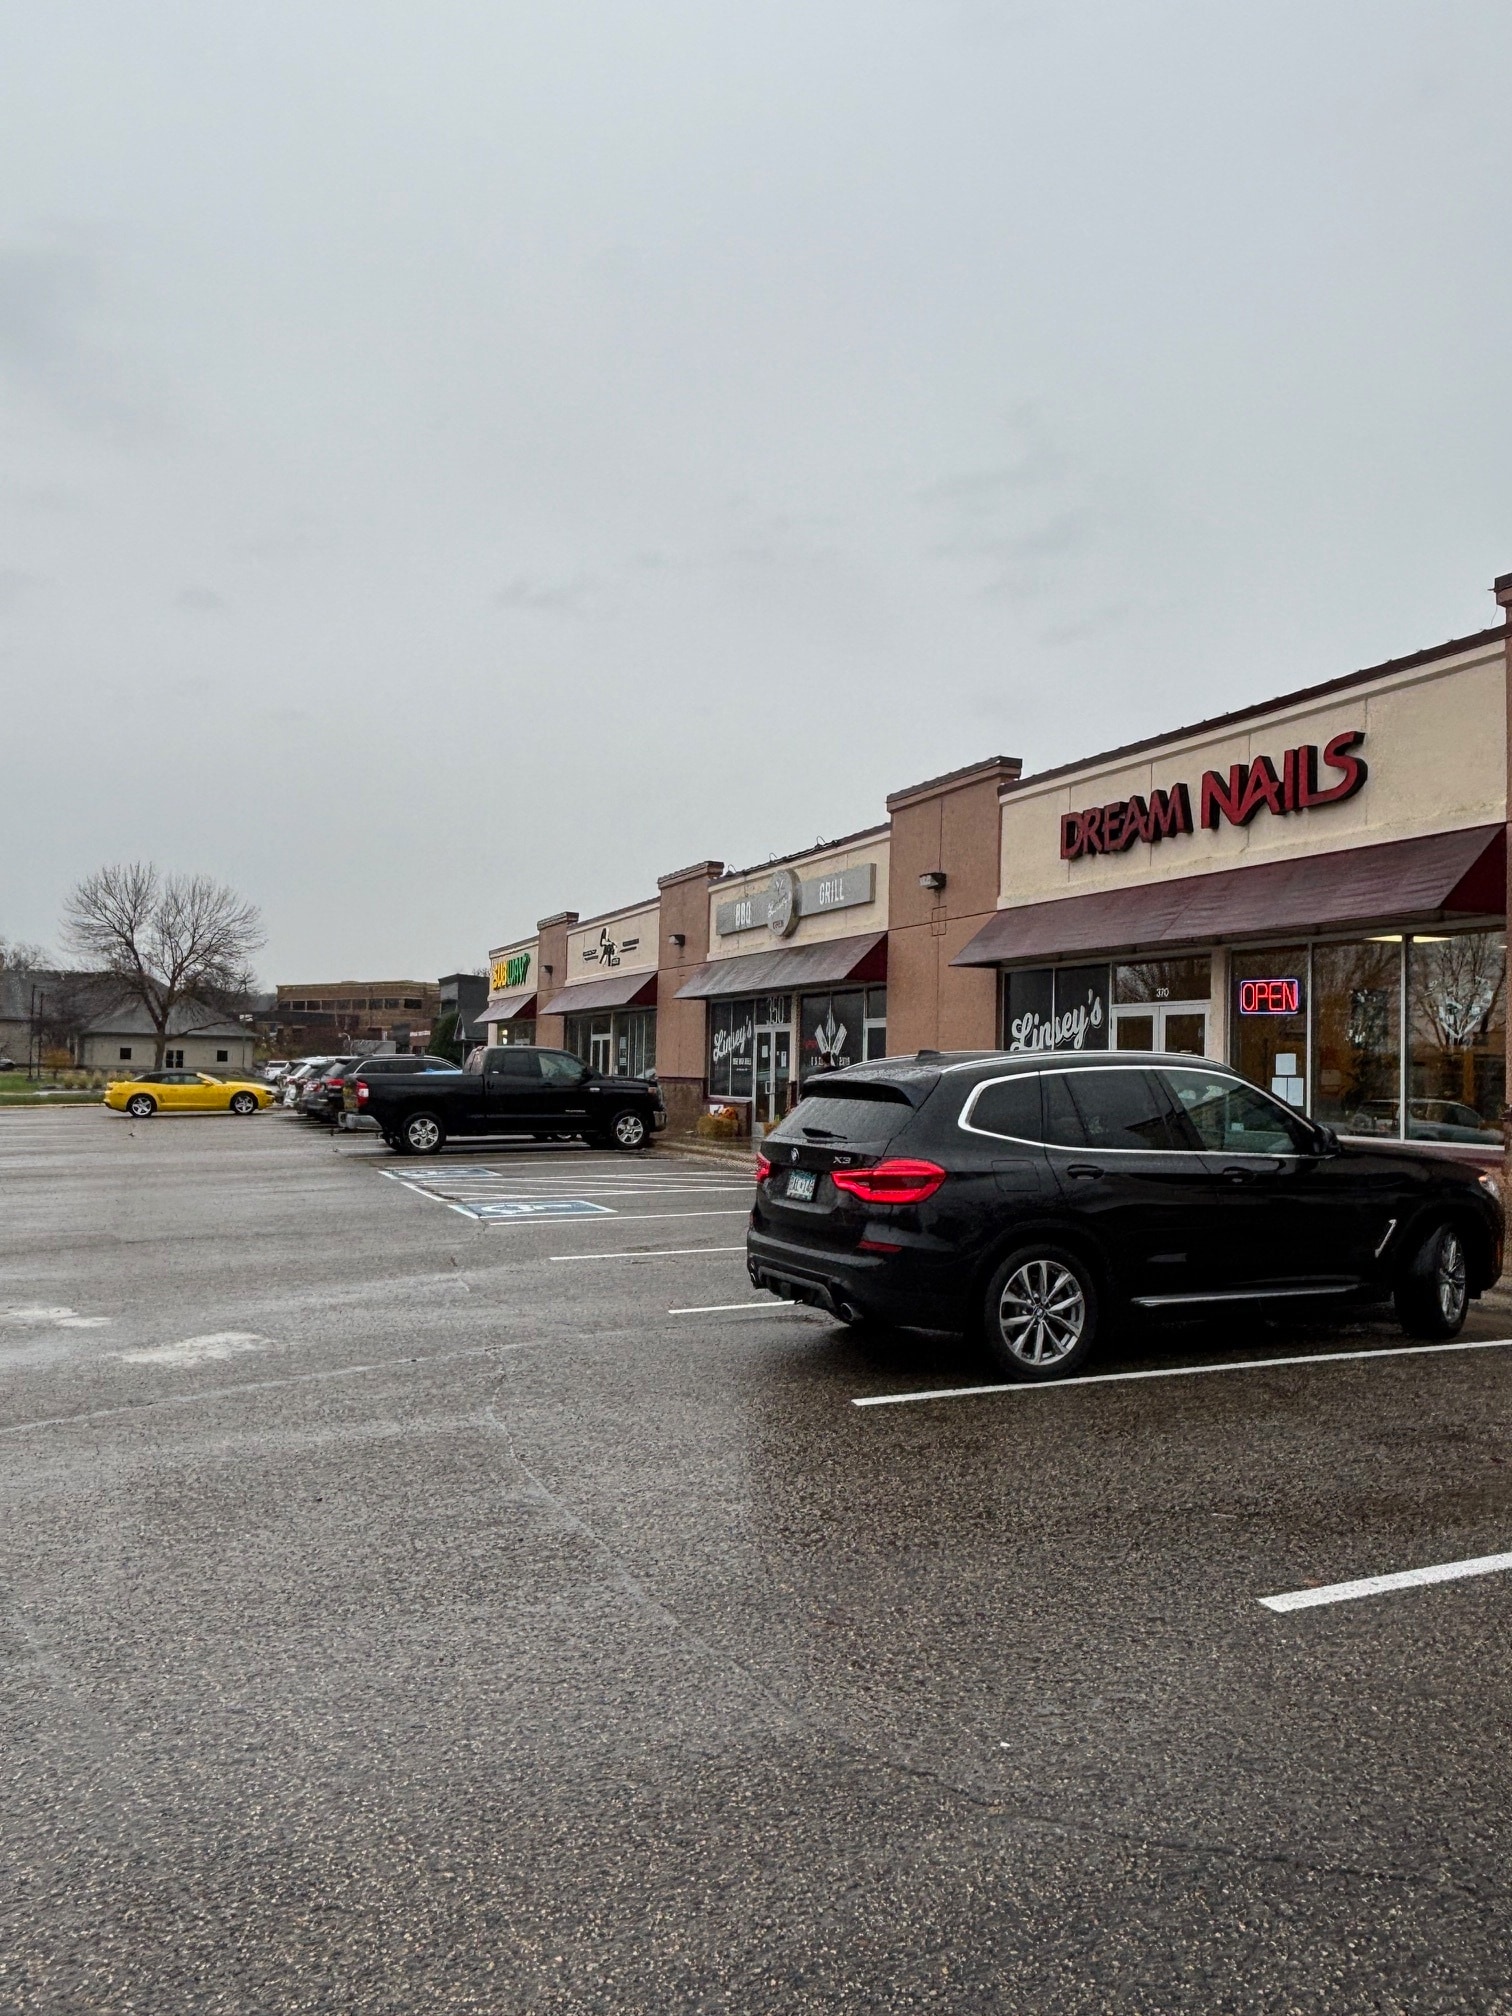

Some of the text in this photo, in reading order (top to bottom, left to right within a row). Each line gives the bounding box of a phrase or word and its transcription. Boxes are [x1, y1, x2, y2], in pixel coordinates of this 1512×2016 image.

[1060, 731, 1368, 860] DREAM NAILS
[819, 878, 844, 905] GRILL
[492, 952, 531, 990] SUBWAY
[1156, 987, 1170, 998] 370
[1241, 982, 1298, 1011] OPEN
[832, 1156, 851, 1164] X3
